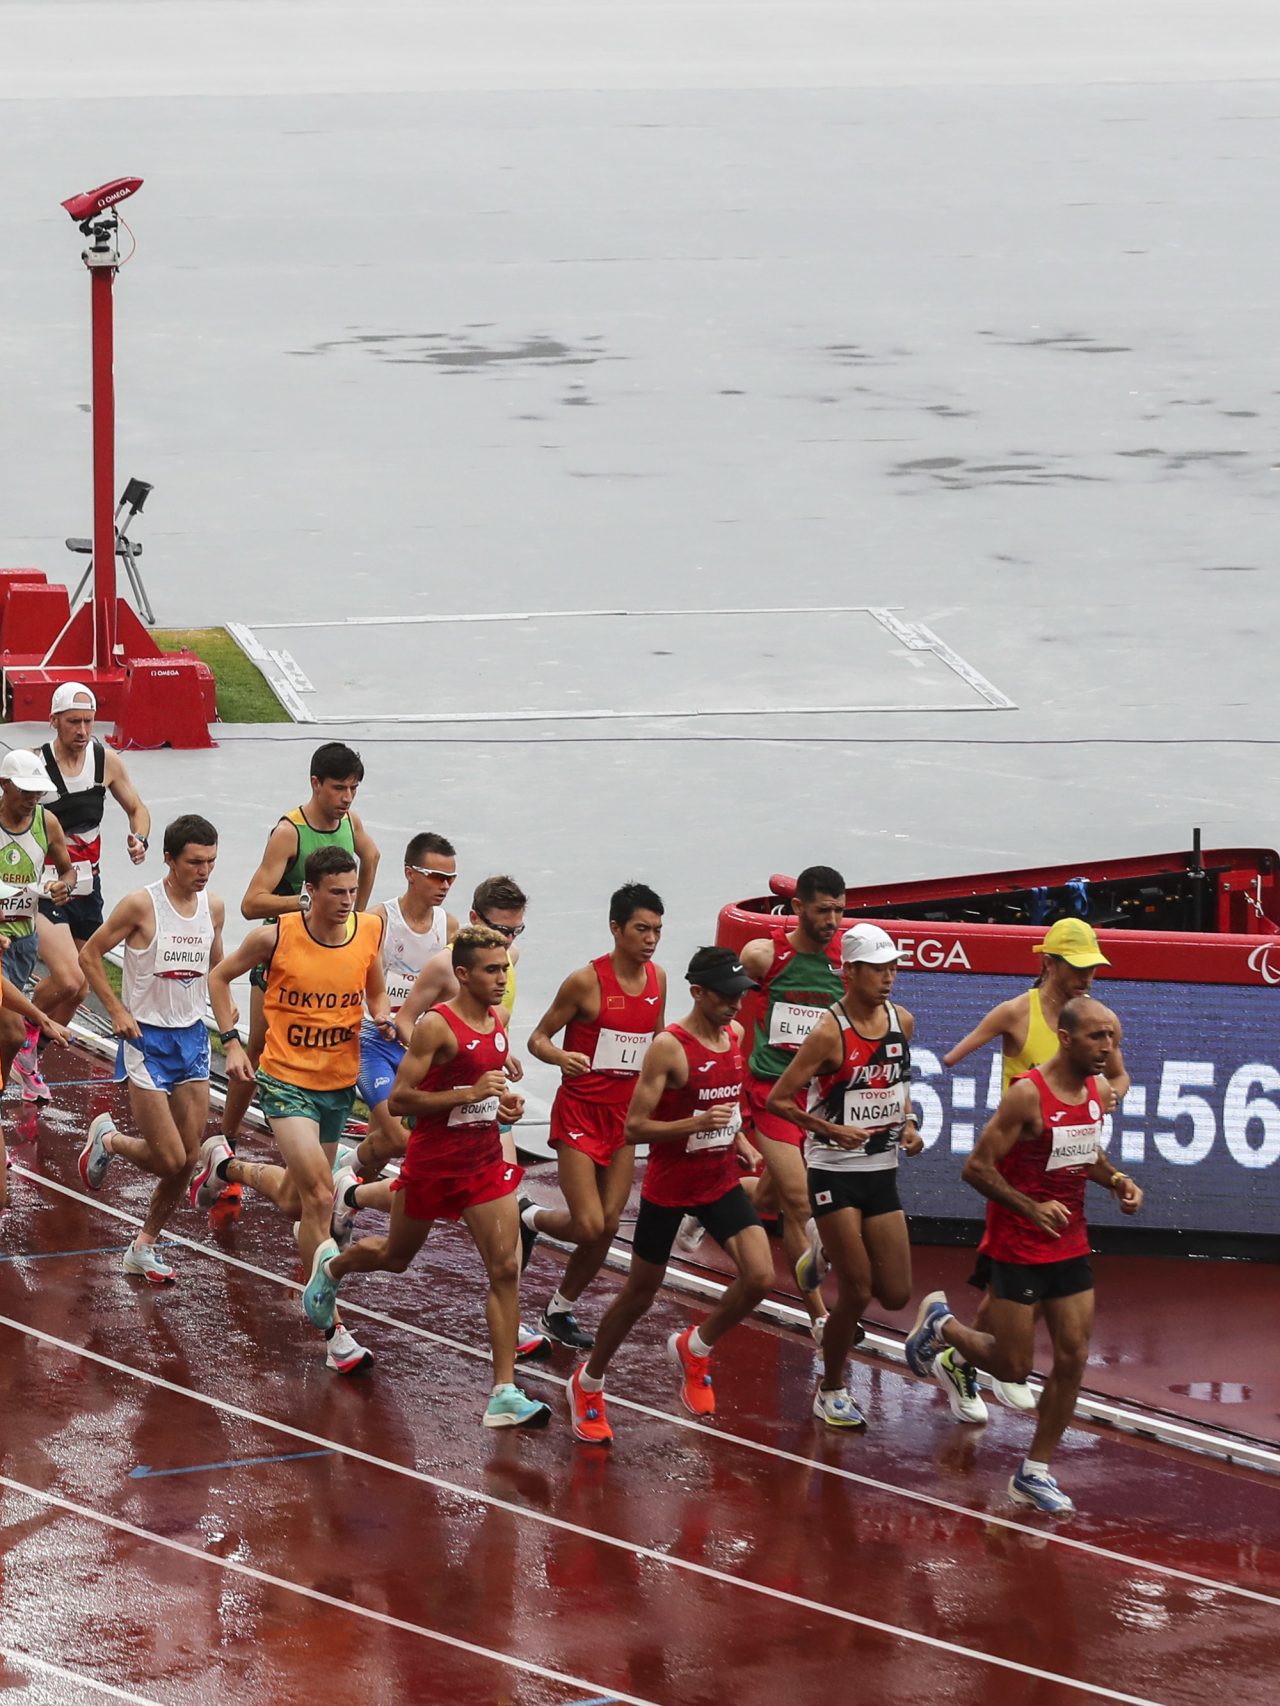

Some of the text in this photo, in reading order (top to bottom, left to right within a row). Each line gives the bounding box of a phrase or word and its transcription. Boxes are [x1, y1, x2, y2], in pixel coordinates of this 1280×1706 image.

[105, 188, 131, 203] OMEGA
[1, 873, 31, 884] GERIA
[1, 897, 32, 911] RFAS
[172, 936, 203, 944] TOYOTA
[163, 950, 206, 962] GAVRILOV
[896, 938, 972, 969] EGA
[278, 987, 337, 1008] TOKYO
[788, 1006, 824, 1018] TOYOTA
[780, 1022, 793, 1034] EL
[287, 1024, 355, 1048] GUIDE
[615, 1034, 647, 1044] TOYOTA
[621, 1049, 637, 1063] LI
[846, 1062, 901, 1089] JAPAN
[860, 1090, 895, 1100] TOYOTA
[850, 1101, 900, 1121] NAGATA
[1065, 1127, 1096, 1138] TOYOTA
[1052, 1144, 1097, 1158] NASRALLA
